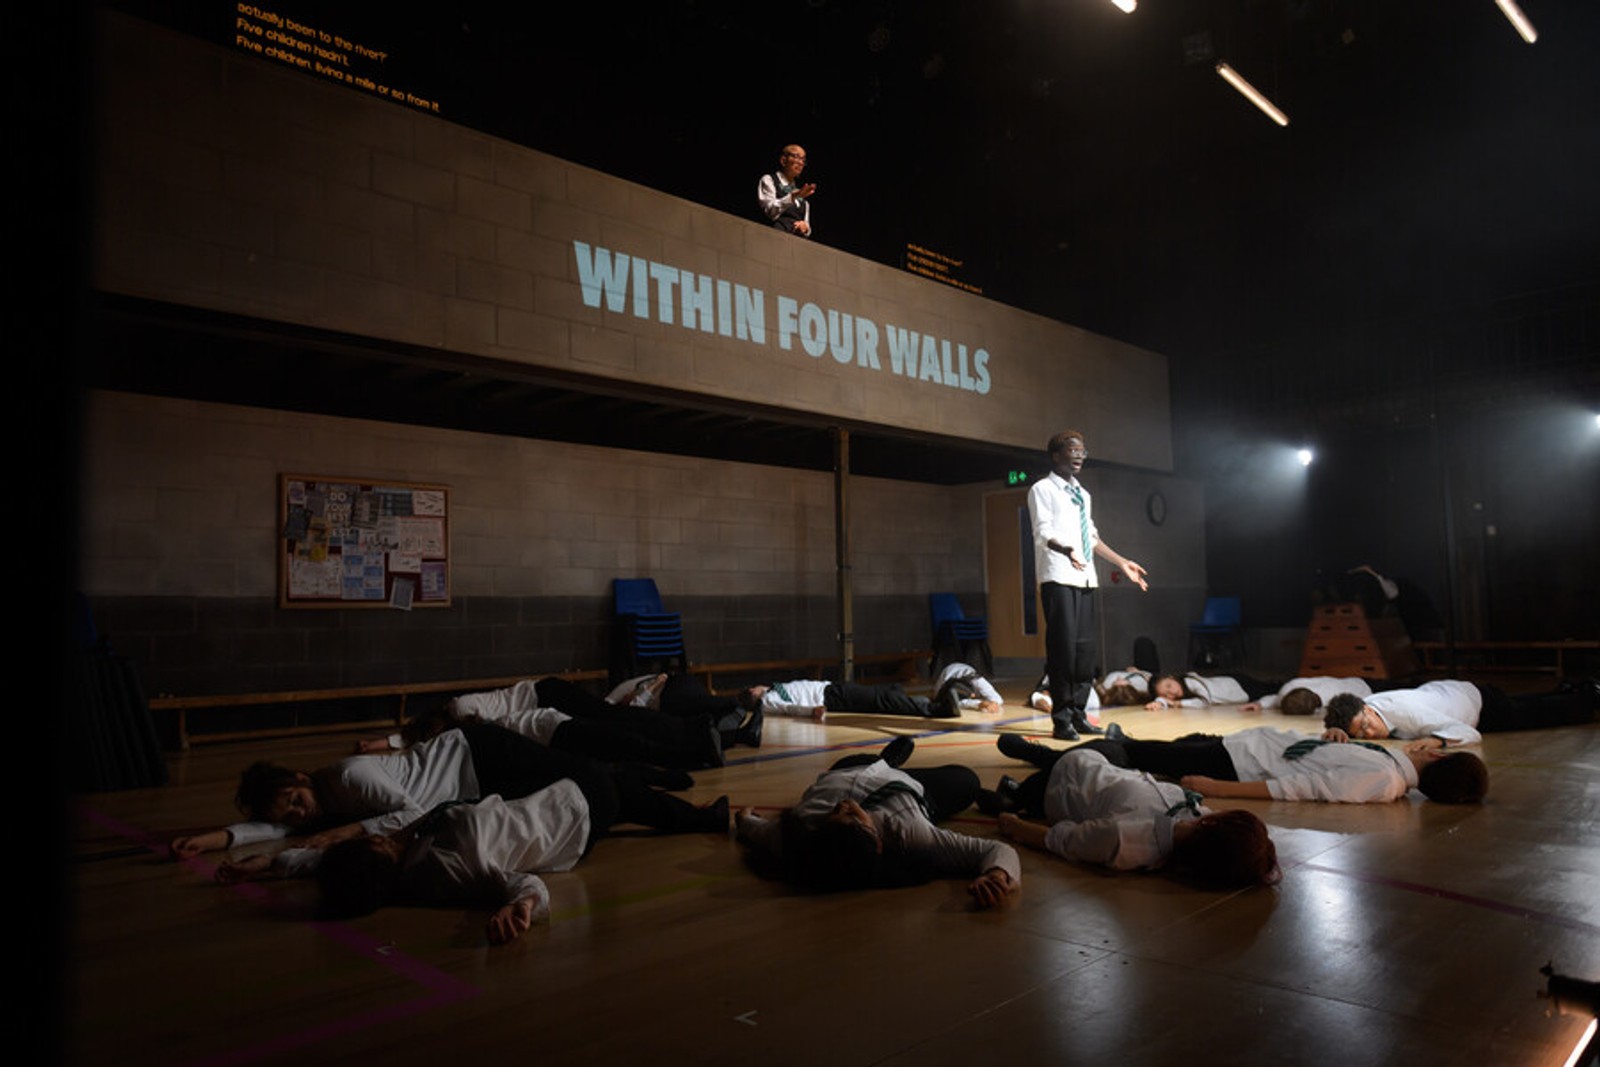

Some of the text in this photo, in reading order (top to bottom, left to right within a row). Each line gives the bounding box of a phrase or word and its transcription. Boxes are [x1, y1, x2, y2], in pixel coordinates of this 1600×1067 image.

[236, 17, 263, 36] Five
[265, 30, 312, 53] children
[237, 3, 284, 28] actually
[286, 18, 316, 38] been
[319, 30, 332, 43] to
[334, 35, 353, 51] the
[236, 35, 262, 53] Five
[315, 60, 344, 80] living
[345, 73, 353, 84] a
[355, 75, 376, 91] mile
[378, 84, 389, 95] or
[391, 88, 404, 101] so
[407, 92, 430, 109] from
[573, 240, 992, 395] WITHIN FOUR WALLS
